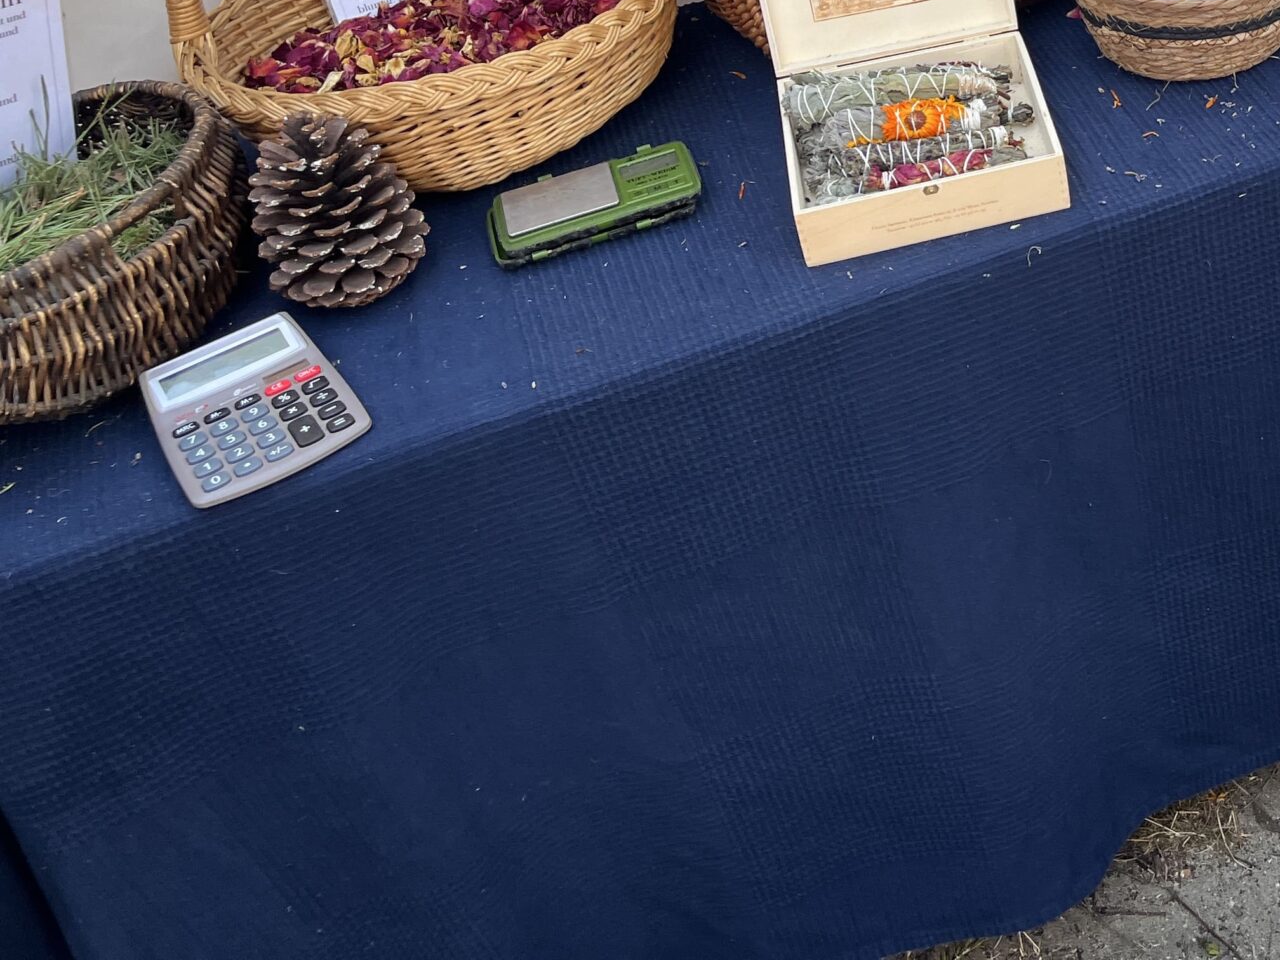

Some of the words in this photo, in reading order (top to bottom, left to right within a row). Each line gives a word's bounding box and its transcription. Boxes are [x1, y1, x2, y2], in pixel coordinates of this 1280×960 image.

[249, 407, 258, 416] 9
[219, 421, 228, 430] 8
[258, 419, 268, 428] 6
[187, 436, 196, 444] 7
[226, 435, 236, 443] 5
[266, 433, 276, 442] 3
[234, 448, 244, 456] 2
[211, 475, 221, 484] 0
